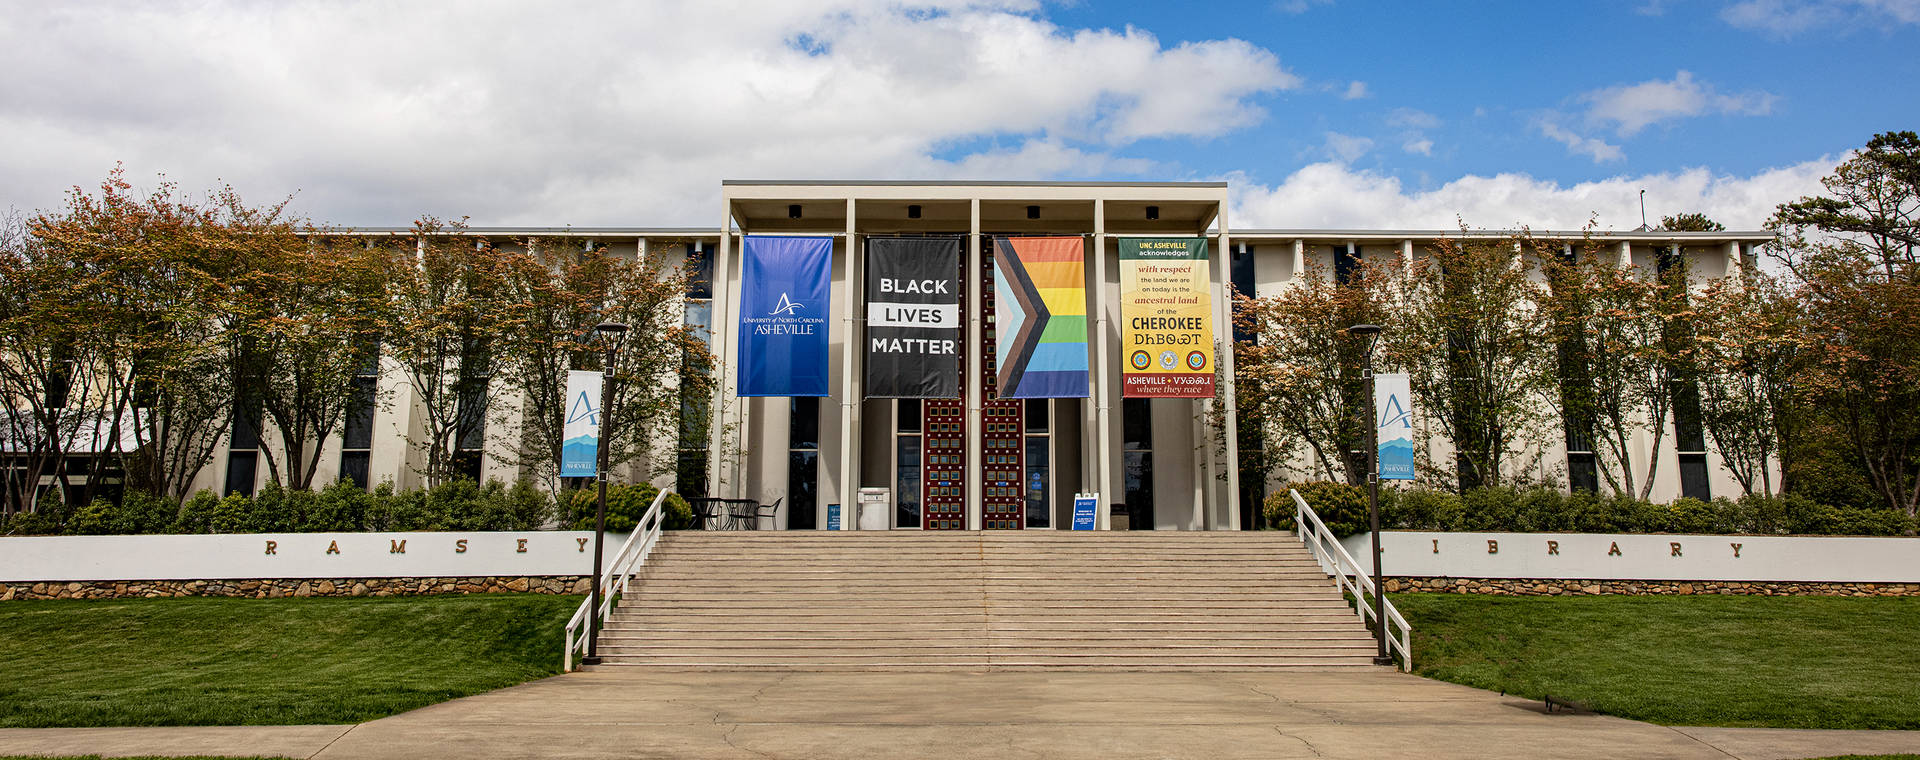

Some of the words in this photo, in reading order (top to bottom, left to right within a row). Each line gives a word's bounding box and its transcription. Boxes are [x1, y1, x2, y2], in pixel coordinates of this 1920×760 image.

[1138, 265, 1158, 273] with
[1160, 265, 1192, 275] respect
[880, 278, 948, 294] BLACK
[1134, 296, 1176, 304] ancestral
[1178, 296, 1198, 304] land
[885, 307, 942, 323] LIVES
[754, 324, 814, 335] ASHEVILLE
[1132, 317, 1202, 330] CHEROKEE
[872, 338, 955, 354] MATTER
[1127, 376, 1166, 385] ASHEVILLE
[1137, 385, 1162, 393] where
[1163, 385, 1182, 395] they
[265, 537, 588, 556] RAMSEY
[1380, 539, 1742, 558] IBRARY
